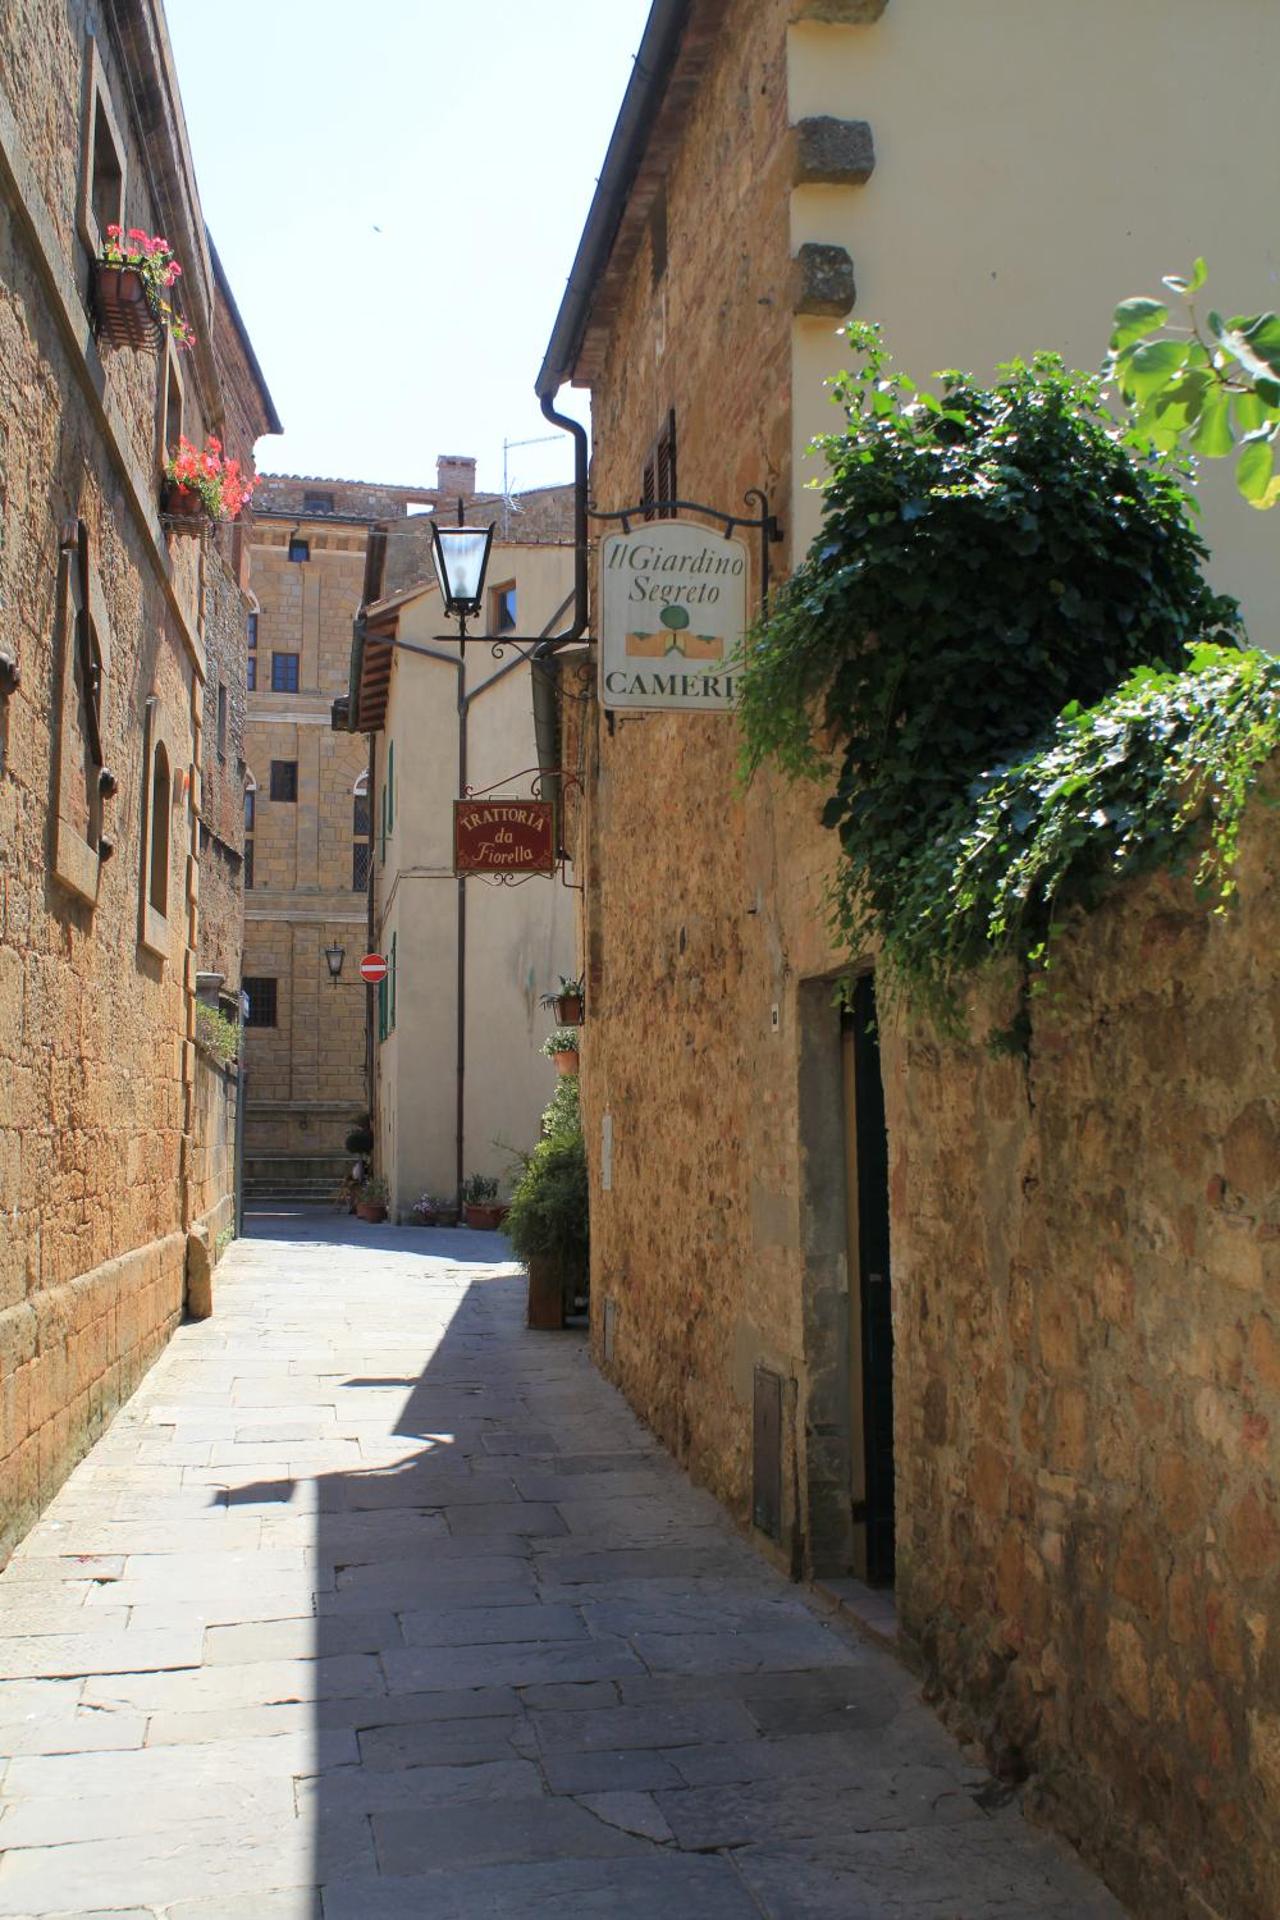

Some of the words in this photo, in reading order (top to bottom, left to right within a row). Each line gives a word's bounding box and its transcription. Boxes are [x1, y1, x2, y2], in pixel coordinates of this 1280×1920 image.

[608, 544, 629, 570] Il
[629, 546, 743, 576] Giardino
[628, 576, 720, 605] Segreto
[460, 808, 544, 832] TRATTORIA
[494, 827, 513, 843] da
[472, 841, 533, 864] Fiorella
